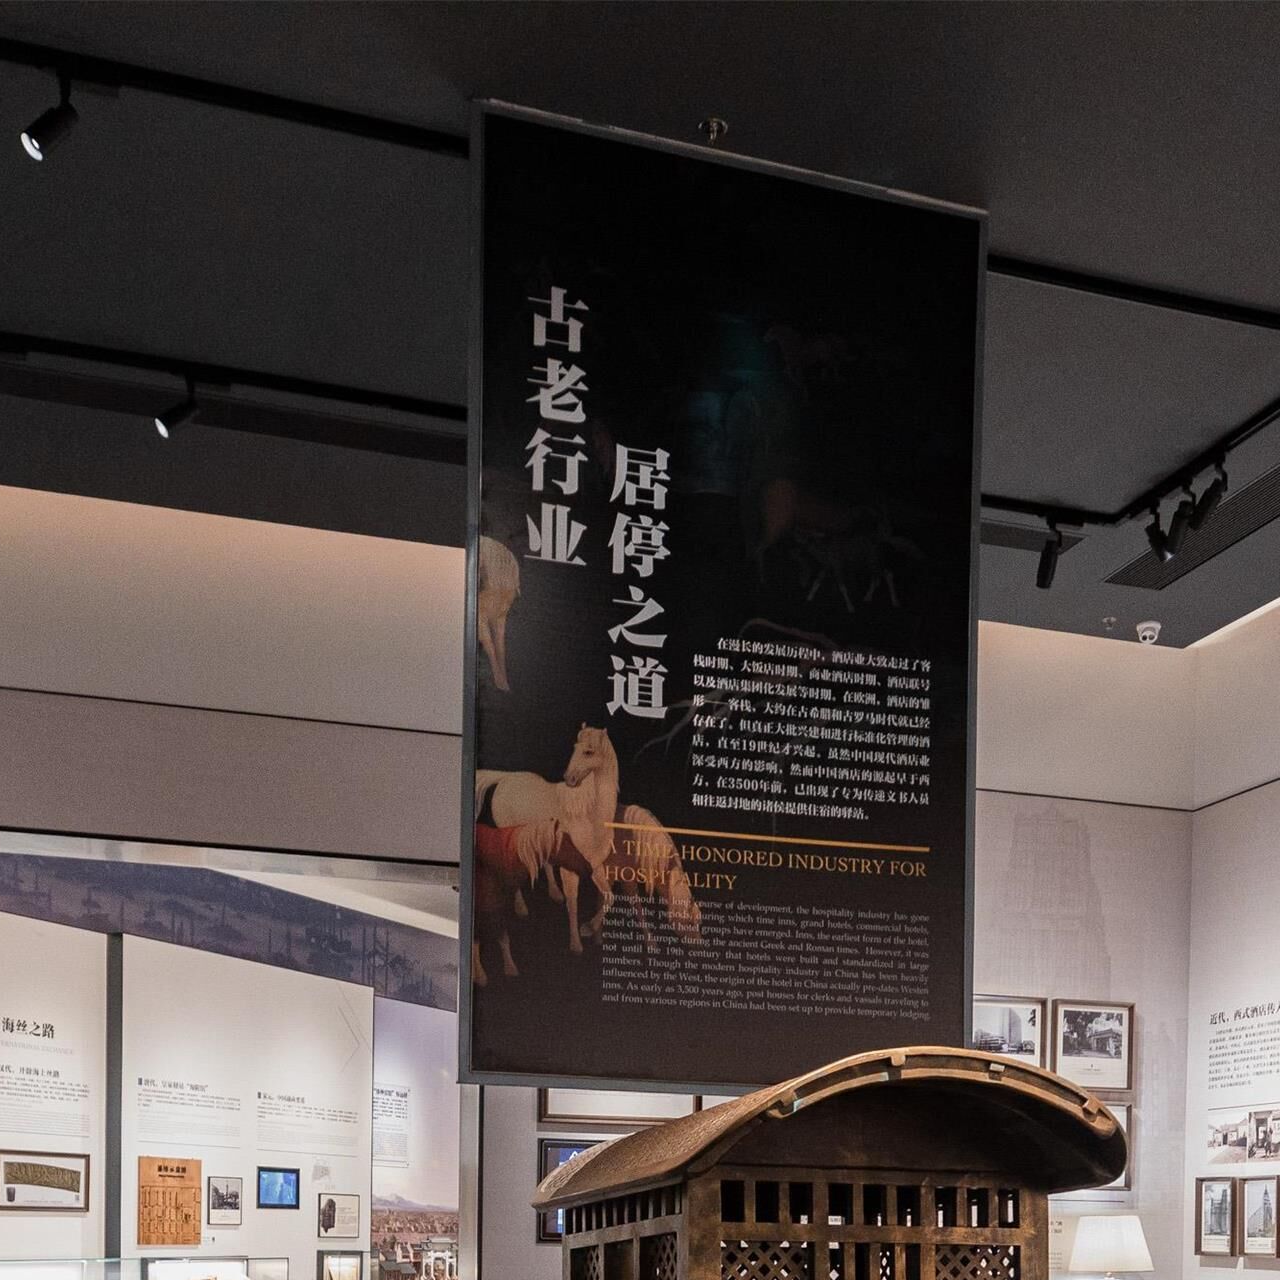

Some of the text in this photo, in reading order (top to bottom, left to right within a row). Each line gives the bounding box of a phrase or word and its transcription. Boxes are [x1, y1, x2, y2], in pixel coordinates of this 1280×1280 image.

[523, 287, 590, 568] 古老行业
[606, 445, 671, 720] 居停之道
[788, 853, 885, 874] INDUSTRY
[890, 861, 927, 877] FOR
[602, 906, 637, 918] through
[641, 908, 655, 916] the
[696, 912, 724, 924] during
[727, 914, 753, 923] which
[756, 916, 774, 924] time
[778, 917, 797, 927] inns,
[800, 919, 824, 930] grand
[827, 920, 853, 930] hotels,
[855, 922, 901, 932] commercial
[904, 925, 929, 935] hotels,
[658, 897, 668, 905] its
[736, 902, 792, 916] development,
[796, 906, 809, 914] the
[812, 907, 853, 920] hospitality
[857, 910, 890, 922] industry
[910, 915, 929, 925] gone
[602, 918, 624, 927] hotel
[626, 920, 656, 930] chains,
[659, 922, 675, 930] and
[677, 923, 699, 931] hotel
[701, 926, 731, 936] groups
[733, 926, 753, 935] have
[754, 928, 792, 940] emerged.
[795, 930, 815, 940] Inns,
[817, 932, 829, 940] the
[831, 933, 860, 942] earliest
[862, 935, 881, 943] form
[907, 938, 928, 947] hotel,
[602, 930, 633, 939] existed
[647, 933, 676, 945] Europe
[680, 935, 710, 947] during
[712, 937, 725, 945] the
[727, 938, 757, 947] ancient
[760, 940, 785, 949] Greek
[787, 942, 803, 950] and
[806, 943, 834, 952] Roman
[602, 943, 617, 951] not
[622, 944, 642, 952] until
[646, 946, 661, 954] the
[665, 947, 684, 955] 19th
[687, 948, 720, 960] century
[724, 950, 741, 959] that
[746, 952, 771, 960] hotels
[799, 955, 818, 963] built
[822, 957, 838, 965] and
[842, 958, 893, 968] standardized
[909, 962, 929, 973] large
[602, 955, 641, 965] numbers.
[647, 958, 680, 970] Though
[684, 960, 698, 968] the
[701, 962, 735, 971] modern
[738, 964, 781, 976] hospitality
[785, 967, 819, 979] industry
[834, 970, 858, 978] China
[879, 973, 897, 981] been
[900, 974, 928, 985] heavily
[602, 968, 648, 978] influenced
[663, 971, 676, 979] the
[678, 972, 702, 982] West,
[704, 974, 717, 982] the
[719, 975, 744, 986] origin
[756, 977, 770, 985] the
[771, 978, 792, 986] hotel
[803, 980, 827, 989] China
[829, 982, 860, 993] actually
[862, 984, 899, 996] pre-dates
[602, 980, 623, 988] inns.
[640, 982, 661, 994] early
[677, 985, 699, 994] 3,500
[701, 988, 723, 997] years
[725, 989, 743, 999] ago,
[746, 989, 764, 1000] post
[766, 990, 794, 999] houses
[796, 992, 808, 1000] for
[810, 993, 834, 1001] clerks
[836, 994, 852, 1002] and
[883, 997, 919, 1009] traveling
[602, 993, 619, 1001] and
[621, 994, 643, 1002] from
[645, 995, 677, 1004] various
[678, 997, 710, 1009] regions
[722, 1000, 747, 1008] China
[749, 1001, 765, 1010] had
[767, 1003, 787, 1011] been
[788, 1004, 800, 1012] set
[824, 1006, 854, 1018] provide
[856, 1008, 897, 1020] temporary
[2, 1017, 55, 1039] 海丝之路
